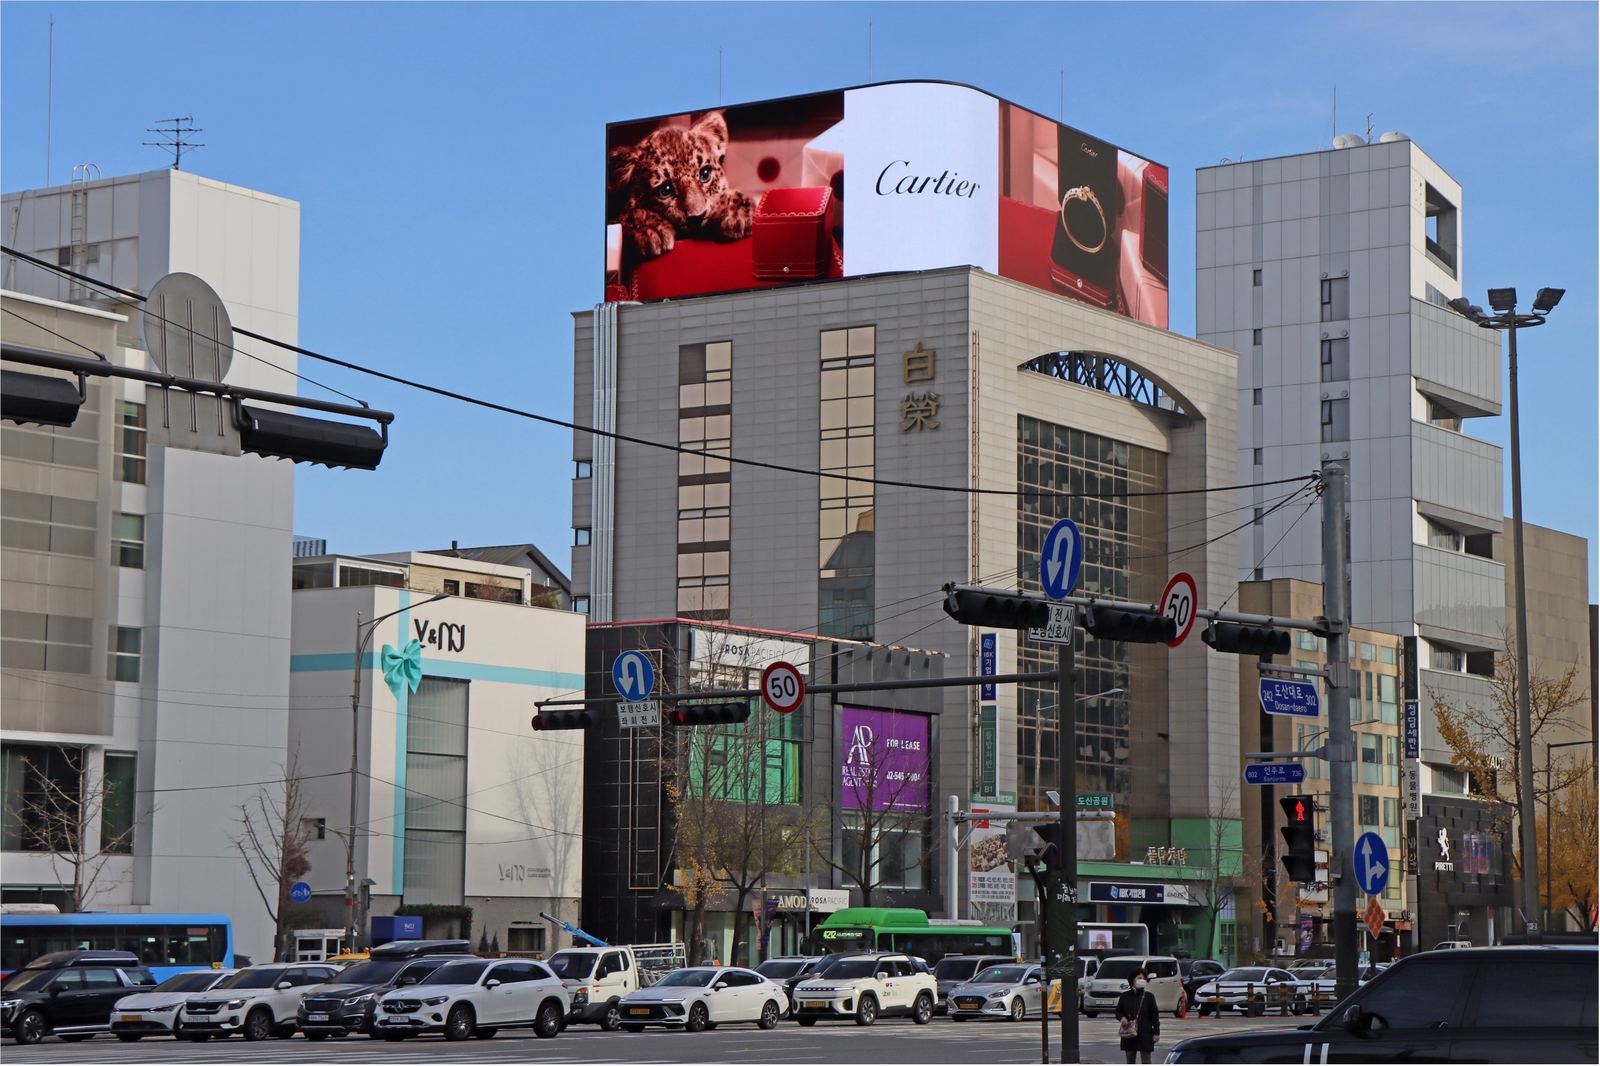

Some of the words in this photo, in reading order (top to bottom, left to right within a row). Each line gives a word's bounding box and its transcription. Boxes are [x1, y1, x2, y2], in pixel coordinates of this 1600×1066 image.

[875, 160, 981, 198] Cartier
[1168, 593, 1190, 626] 50
[771, 676, 796, 699] 50
[1274, 684, 1304, 700] 도산대로
[1262, 690, 1274, 702] 242
[1305, 694, 1317, 706] 302
[886, 738, 899, 749] FOR
[901, 740, 921, 751] LEASE
[1077, 796, 1109, 806] 도산공원
[1435, 861, 1454, 872] PIRETTI
